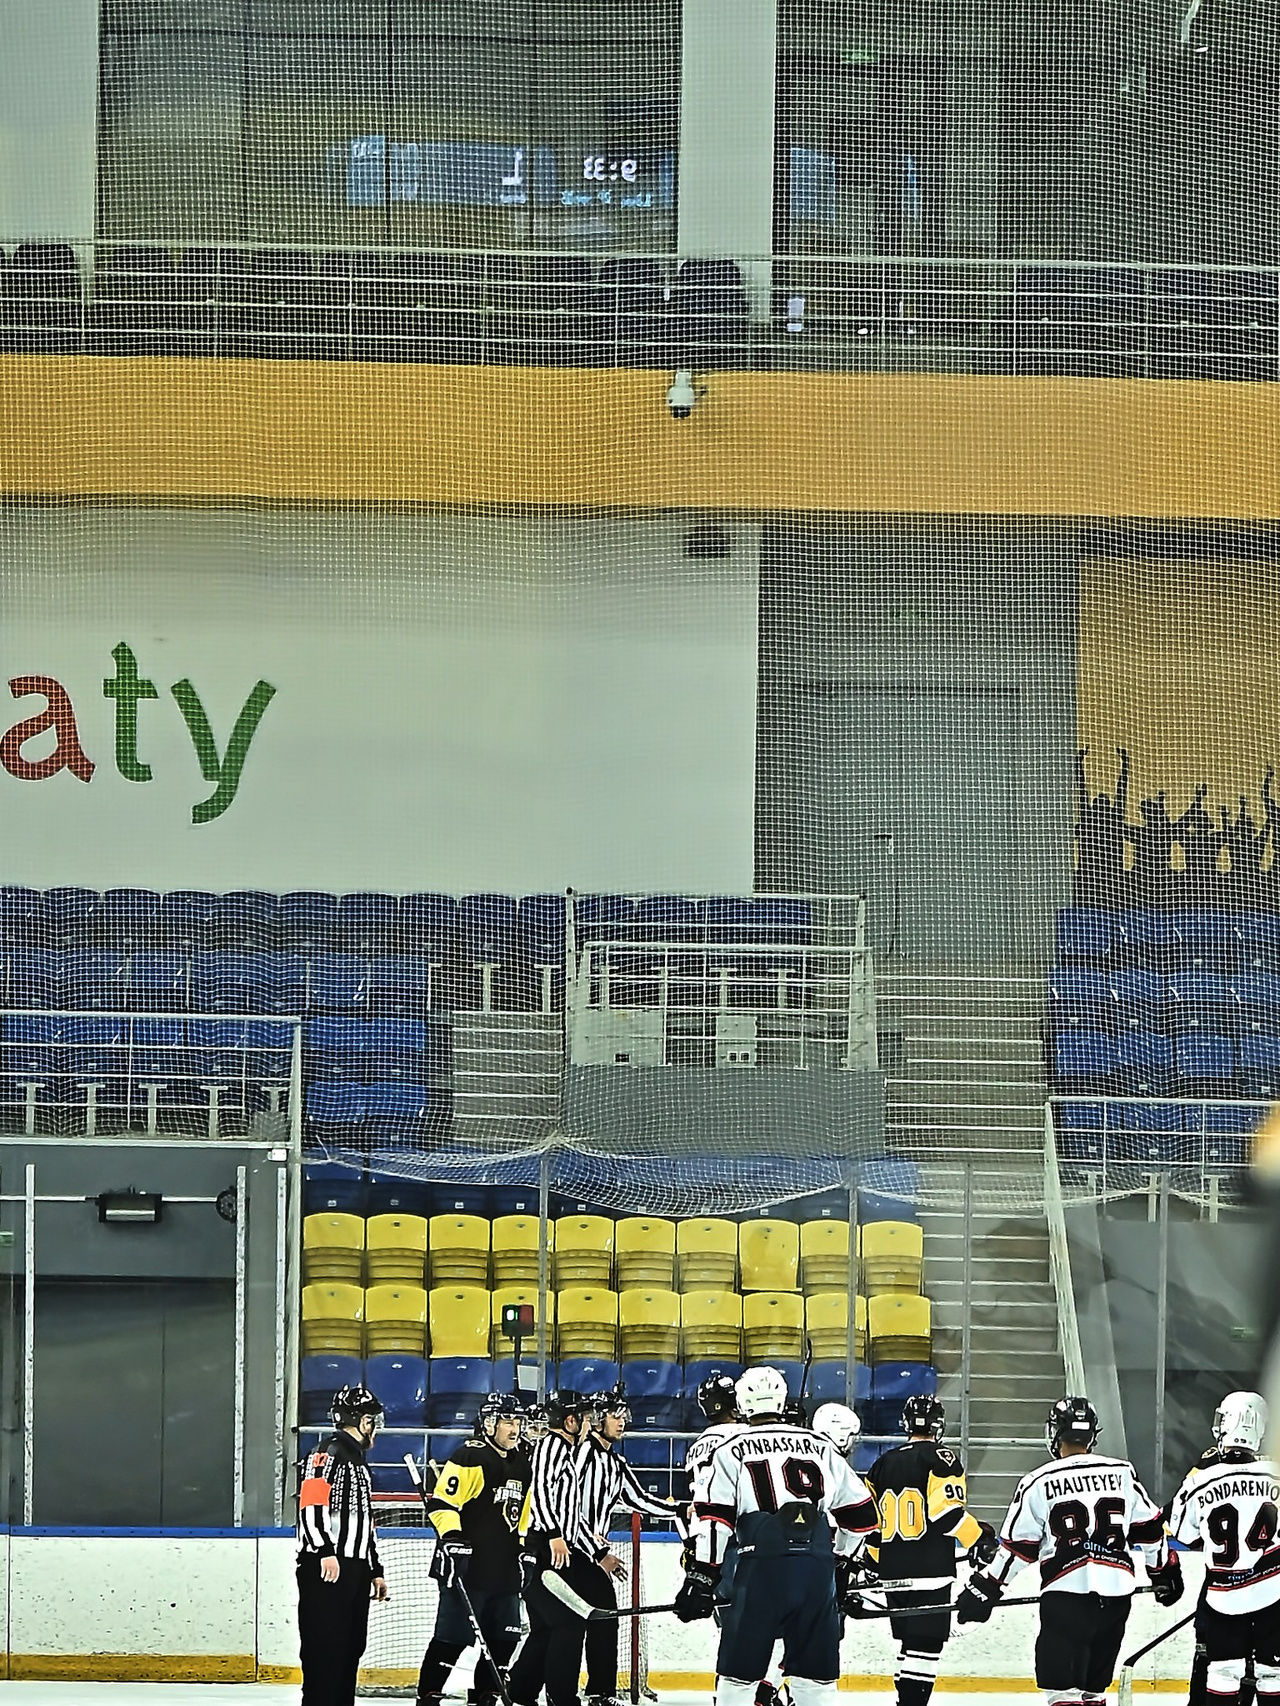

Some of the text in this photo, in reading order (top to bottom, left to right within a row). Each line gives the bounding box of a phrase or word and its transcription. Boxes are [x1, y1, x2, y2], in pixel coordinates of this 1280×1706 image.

[0, 641, 277, 825] aty
[445, 1476, 460, 1496] 9
[744, 1457, 825, 1515] 19
[944, 1483, 965, 1501] 90
[1048, 1496, 1126, 1554] 86
[1207, 1501, 1278, 1568] 94
